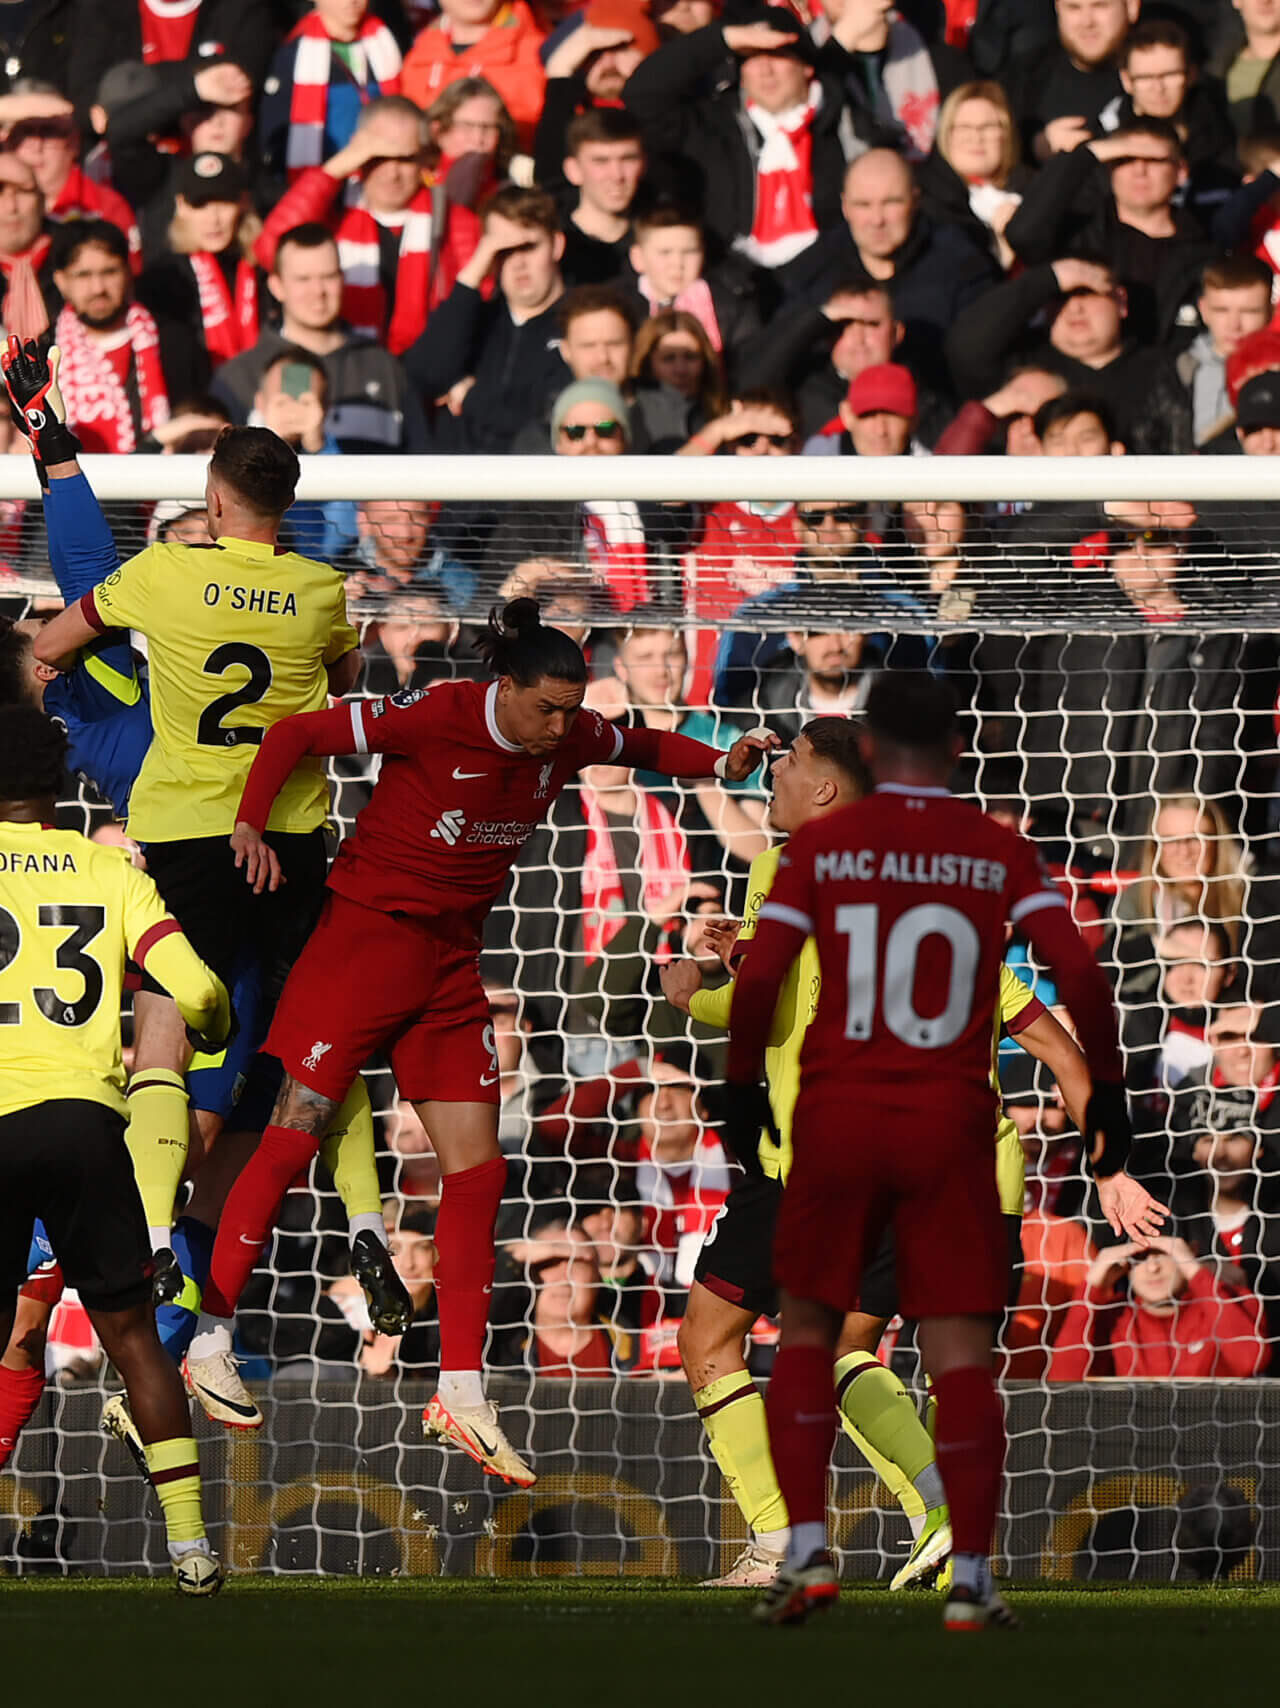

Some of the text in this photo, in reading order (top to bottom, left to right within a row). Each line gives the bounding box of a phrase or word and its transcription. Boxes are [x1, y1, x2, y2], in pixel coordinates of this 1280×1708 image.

[203, 583, 298, 616] O'SHEA
[196, 641, 273, 747] 2
[815, 849, 1006, 892] MAC ALLISTER
[835, 903, 980, 1048] 10
